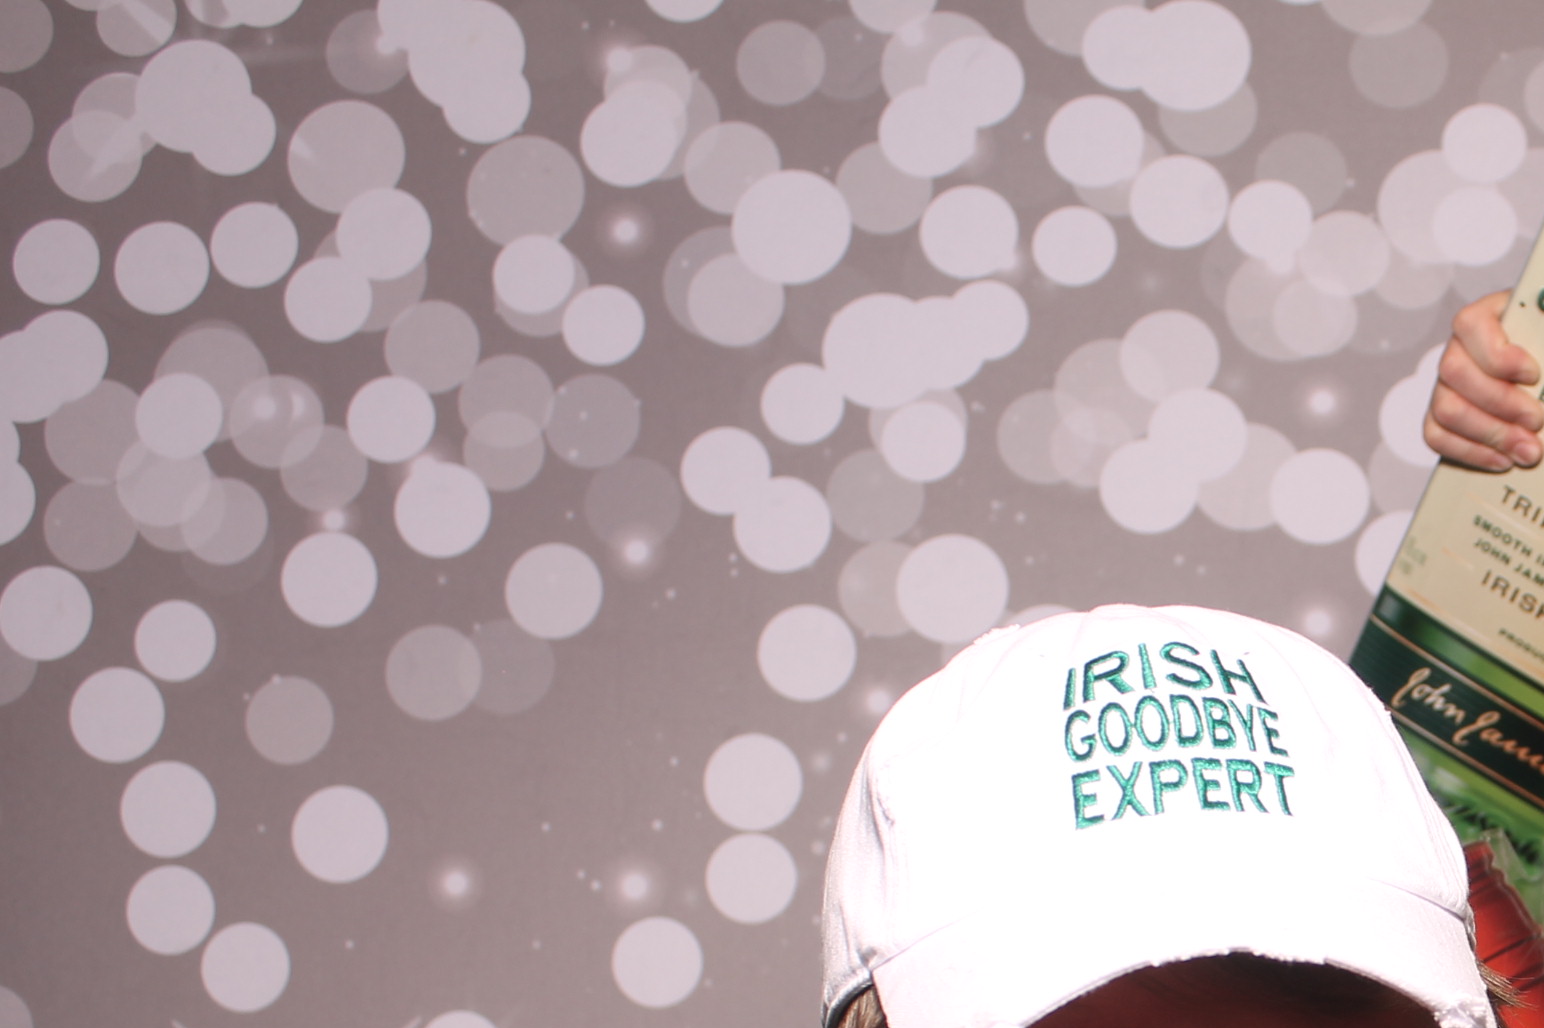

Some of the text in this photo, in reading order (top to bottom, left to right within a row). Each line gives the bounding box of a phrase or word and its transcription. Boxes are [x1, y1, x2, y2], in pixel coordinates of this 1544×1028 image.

[1473, 514, 1532, 557] SMOOTH
[1474, 538, 1511, 566] JOHN
[1063, 641, 1269, 711] IRISH
[1391, 667, 1466, 724] John
[1065, 694, 1290, 762] GOODBYE
[1071, 757, 1296, 830] EXPERT
